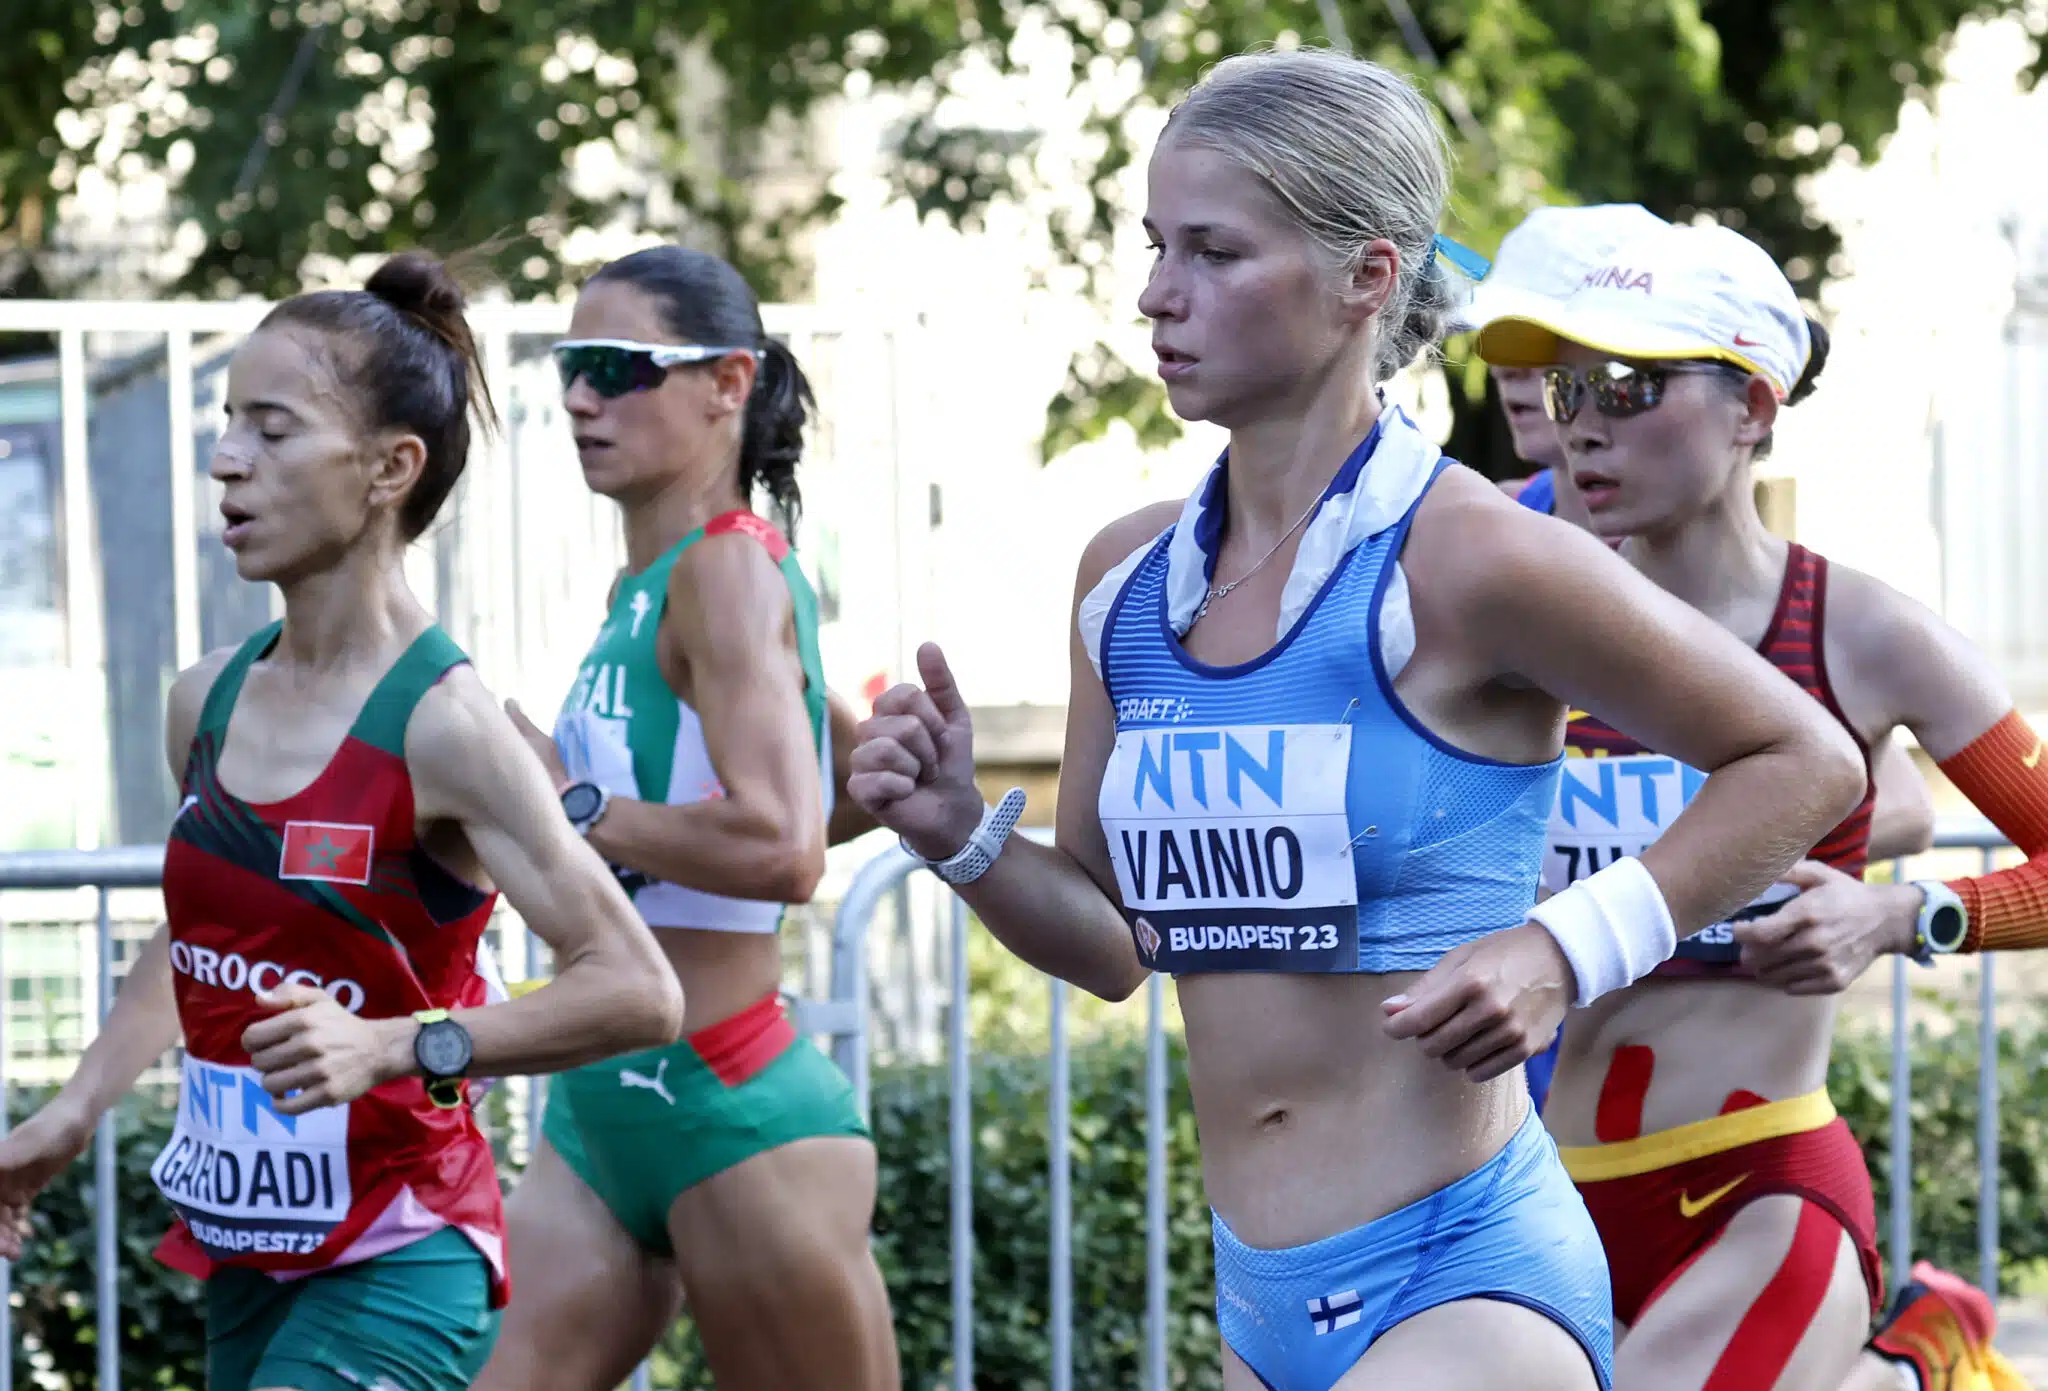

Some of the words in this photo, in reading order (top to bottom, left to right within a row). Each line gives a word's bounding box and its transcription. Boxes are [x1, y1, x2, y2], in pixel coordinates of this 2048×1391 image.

[1119, 697, 1176, 721] CRAFT
[1133, 730, 1285, 812] NTN
[1121, 826, 1303, 901] VAINIO
[1169, 924, 1294, 952] BUDAPEST
[1299, 924, 1339, 951] 23
[188, 1066, 297, 1138] NTN
[160, 1135, 333, 1210] GARDADI
[190, 1219, 299, 1254] BUDAPEST
